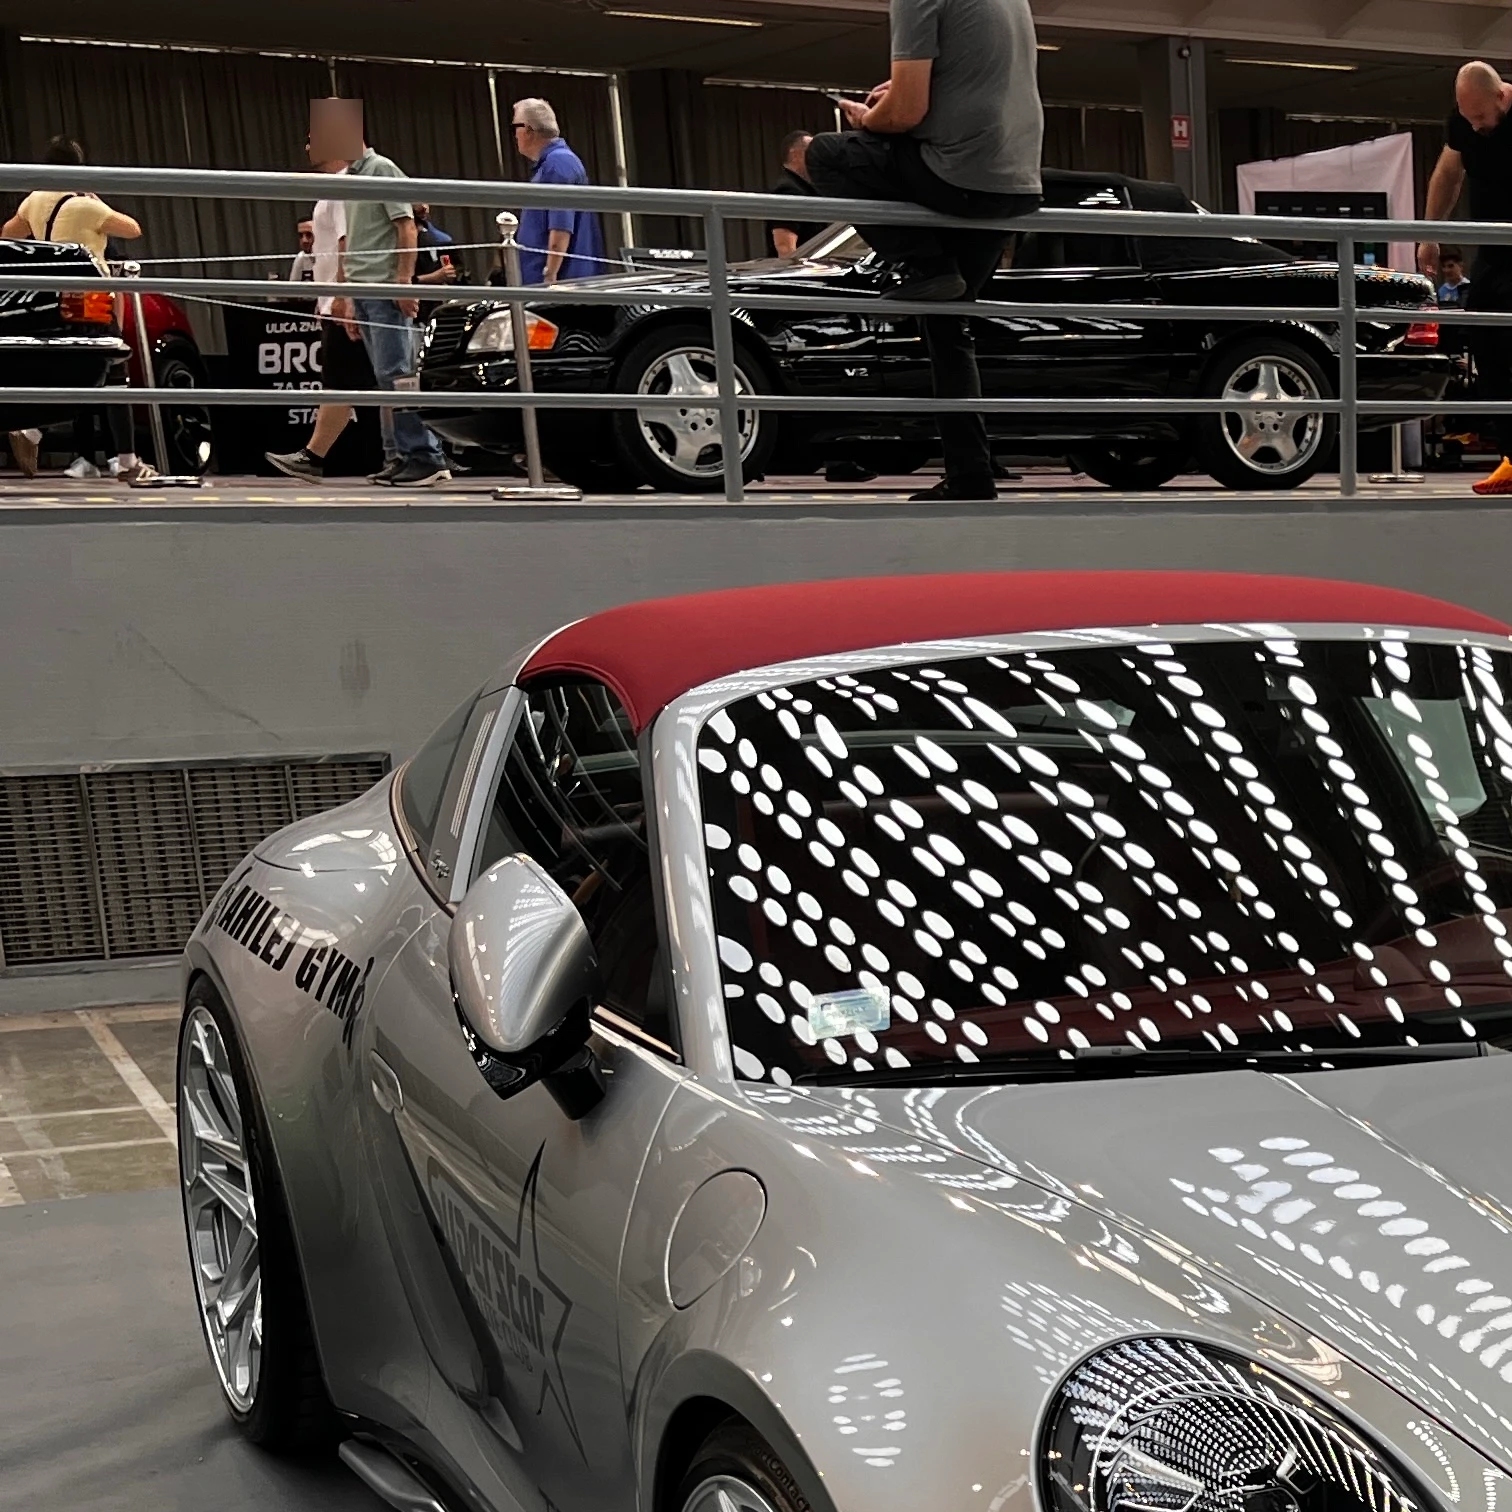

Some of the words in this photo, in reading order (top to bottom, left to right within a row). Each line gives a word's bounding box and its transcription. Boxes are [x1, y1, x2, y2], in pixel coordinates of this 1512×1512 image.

[265, 322, 298, 333] ULICA
[218, 885, 303, 972] AHILEJ
[295, 939, 361, 1020] GYM
